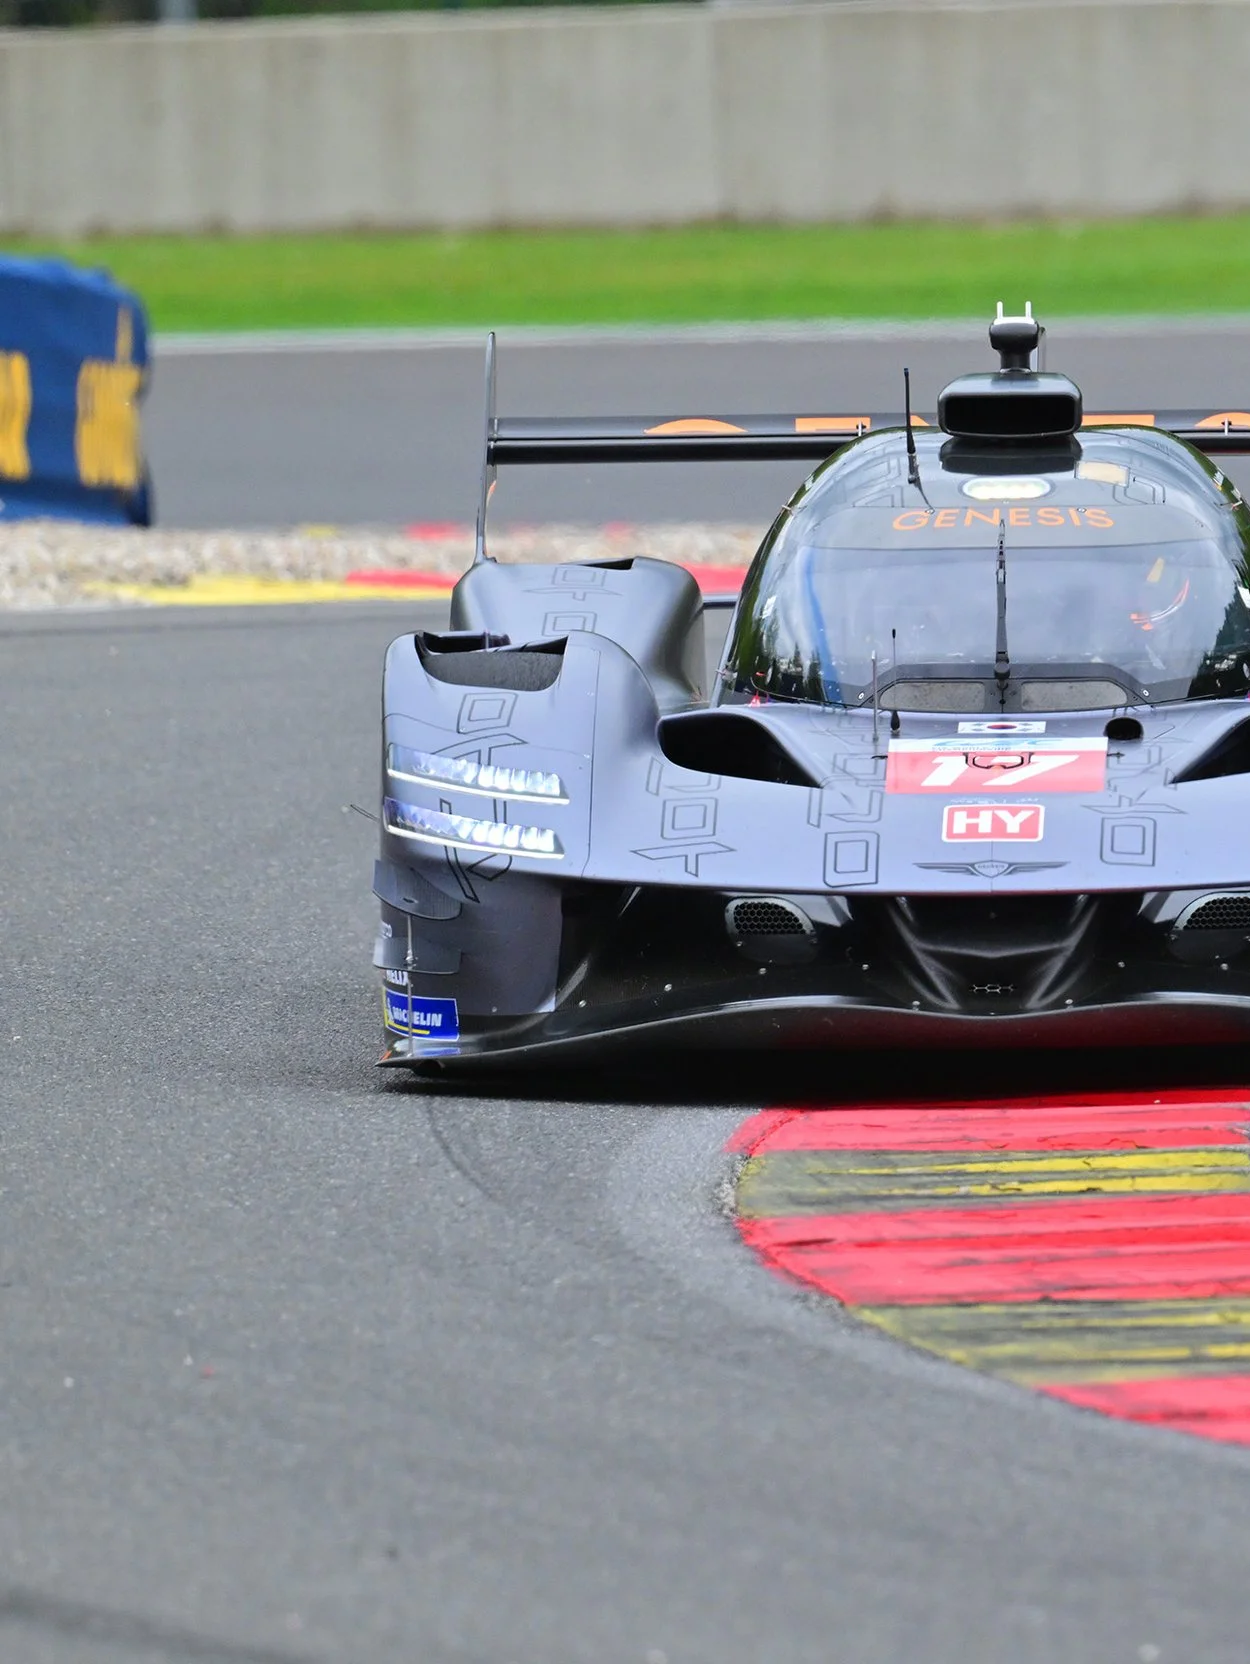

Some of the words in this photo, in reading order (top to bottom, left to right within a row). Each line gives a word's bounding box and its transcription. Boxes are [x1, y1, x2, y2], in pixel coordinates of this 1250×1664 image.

[892, 507, 1115, 531] GENESIS
[920, 753, 1080, 787] 17
[952, 809, 1035, 834] HY
[392, 1007, 442, 1026] MICELIN
